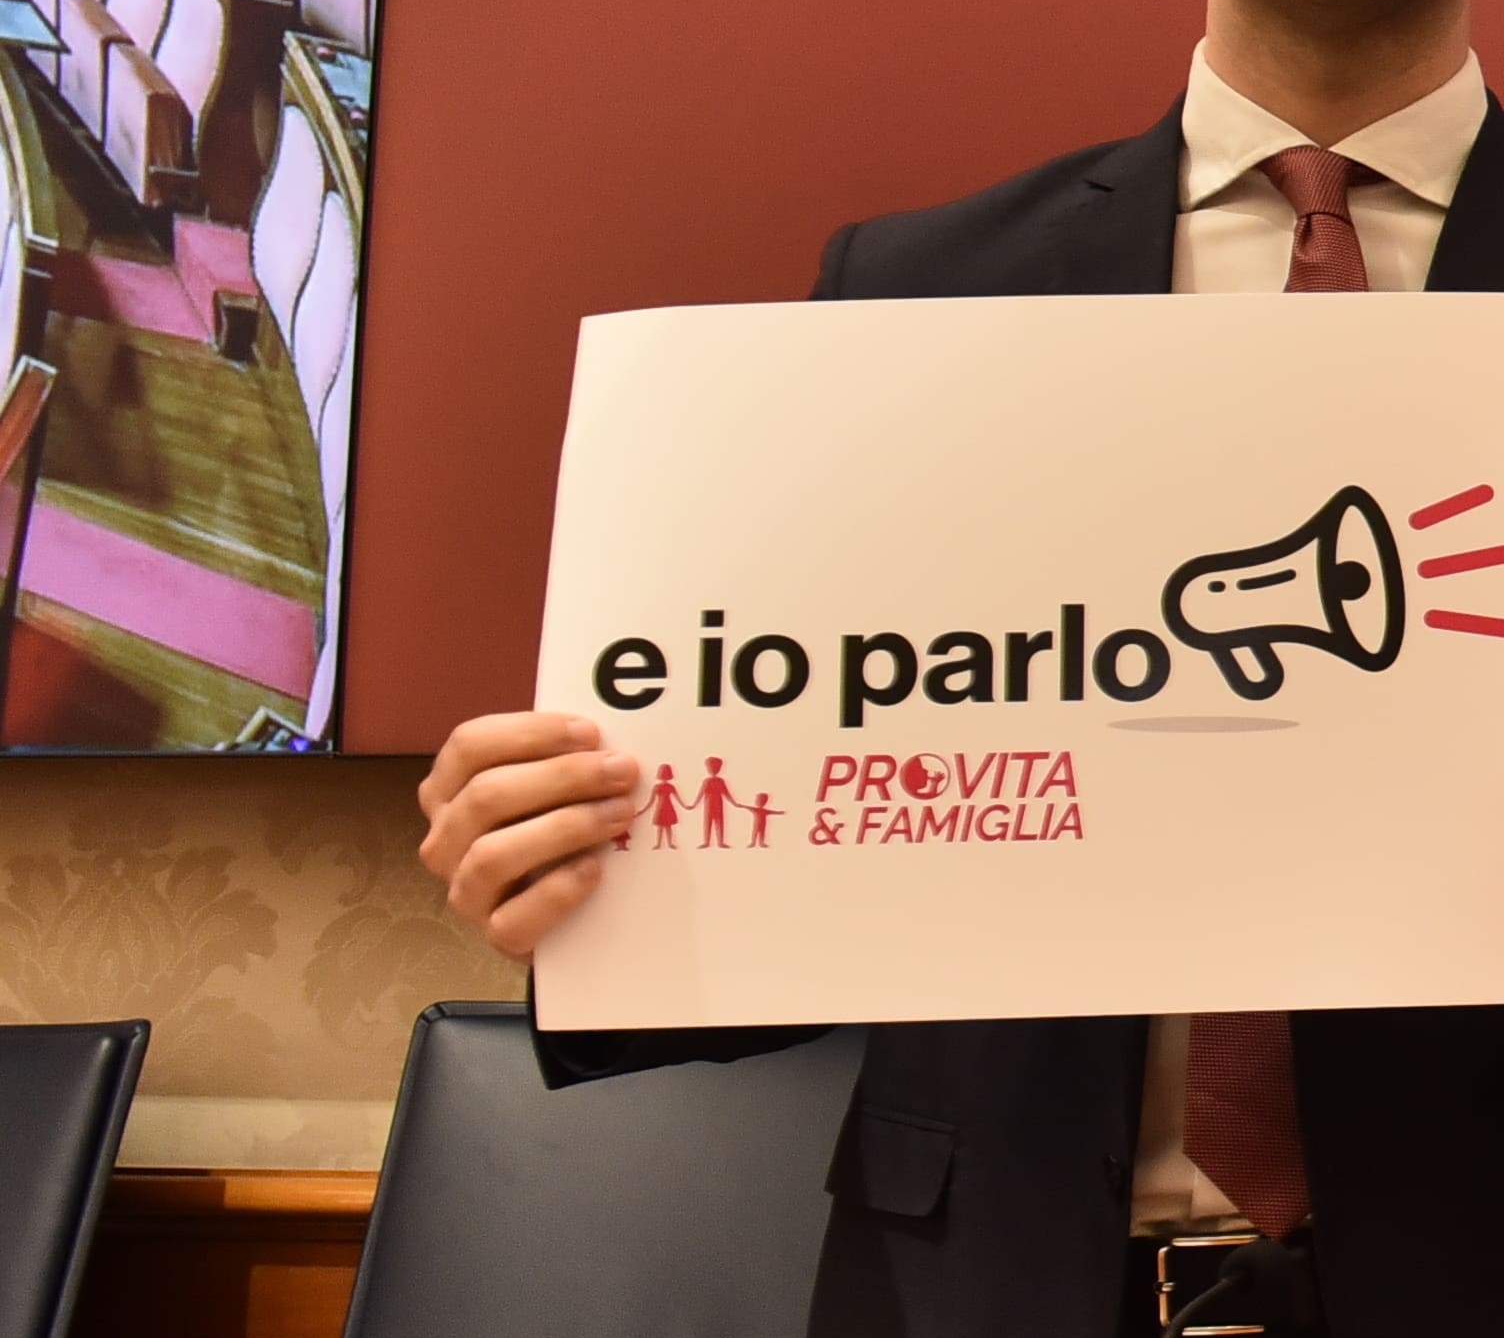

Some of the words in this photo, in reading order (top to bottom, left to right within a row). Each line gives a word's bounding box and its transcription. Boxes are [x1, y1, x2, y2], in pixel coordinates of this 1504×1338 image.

[594, 636, 669, 711] e
[698, 608, 811, 710] io
[839, 601, 1173, 730] parlo
[807, 806, 845, 846] &
[854, 802, 1084, 845] FAMIGLIA
